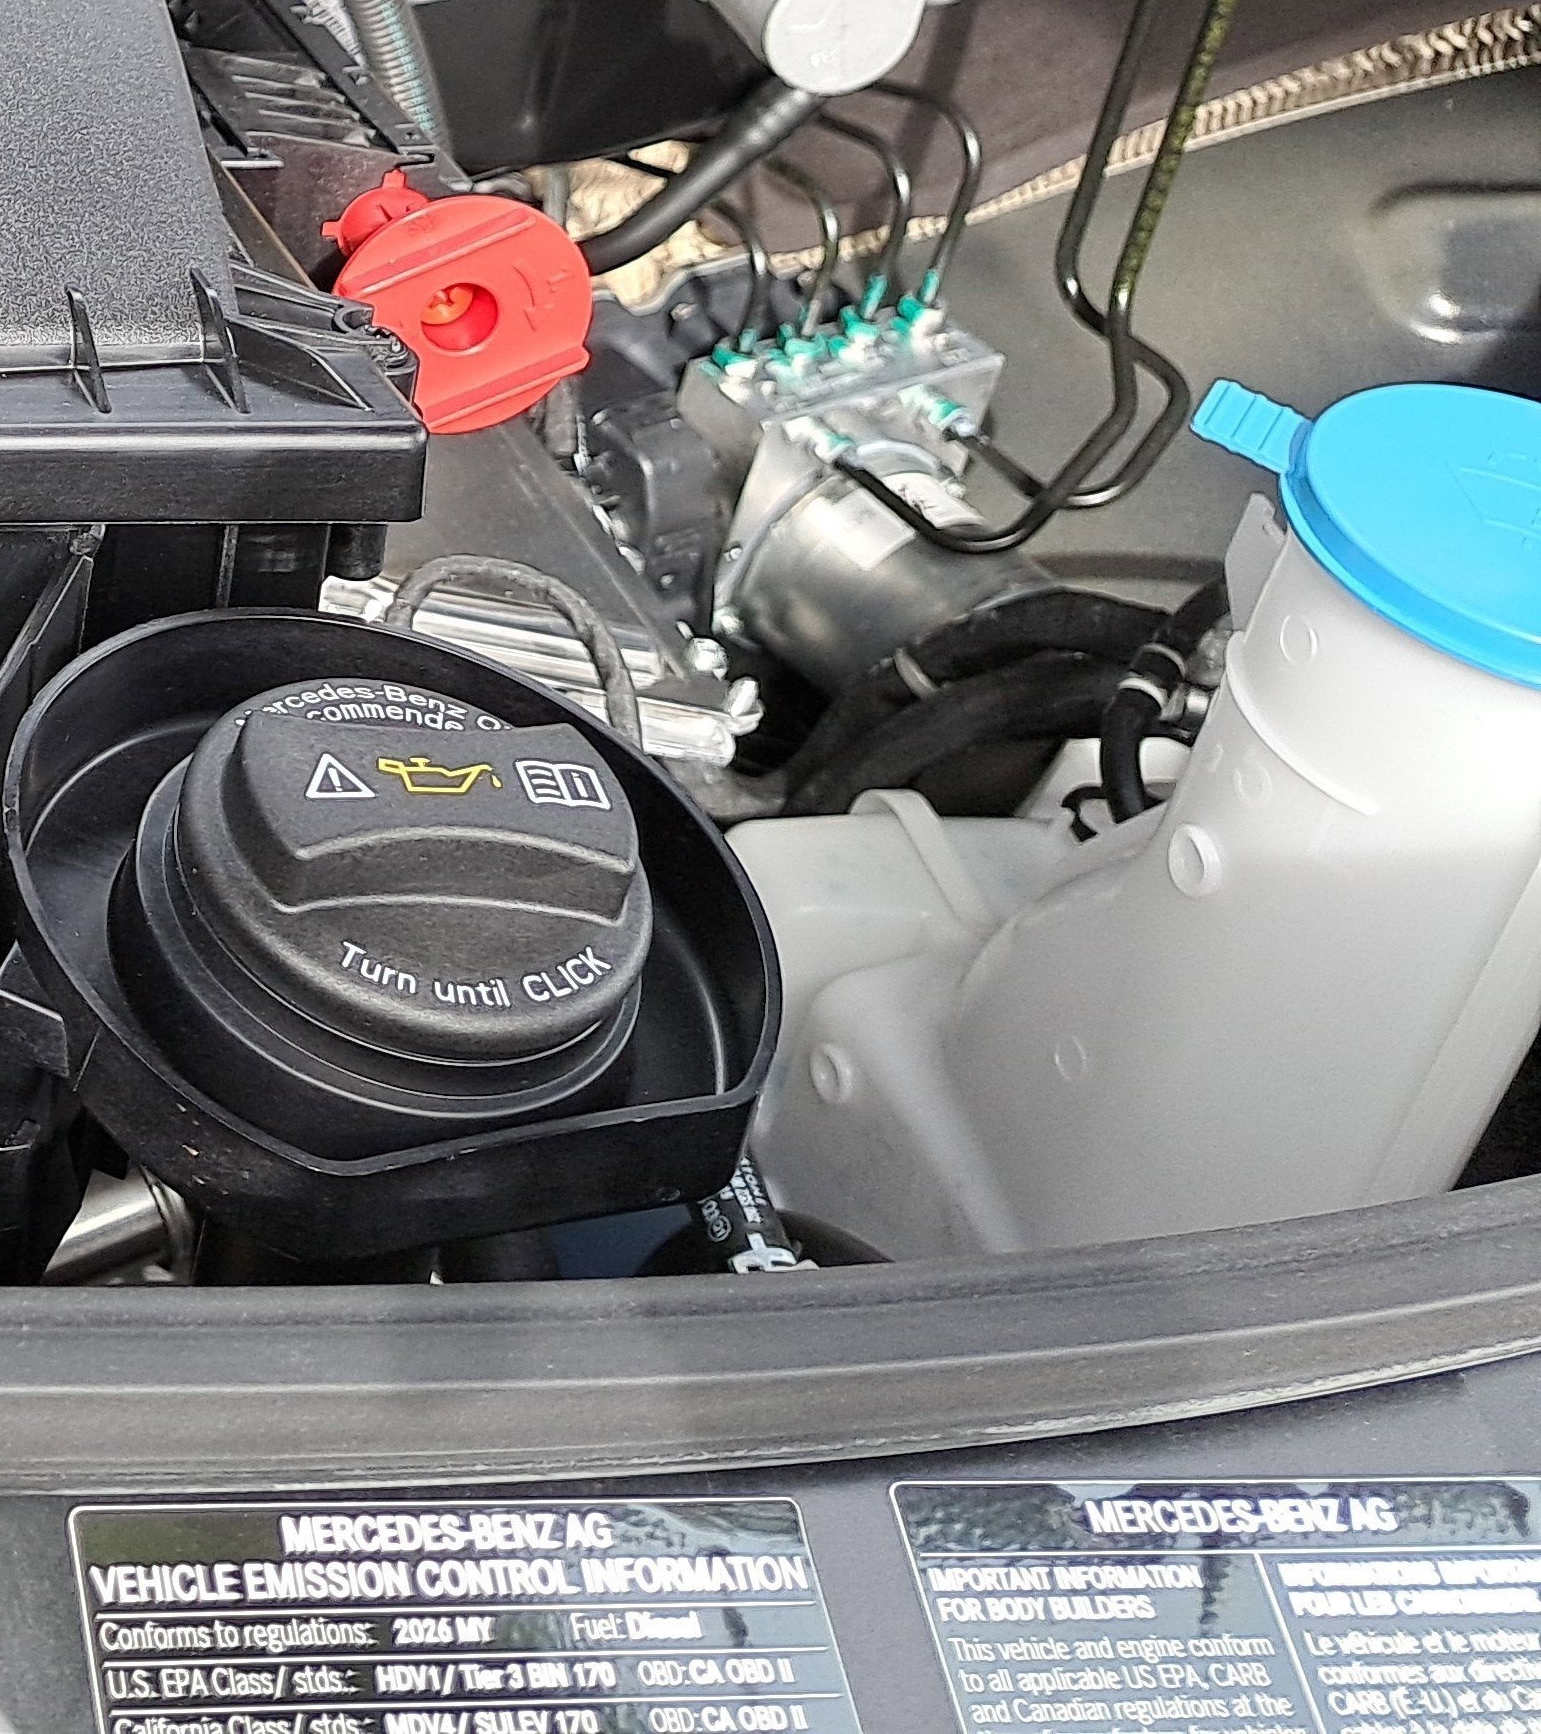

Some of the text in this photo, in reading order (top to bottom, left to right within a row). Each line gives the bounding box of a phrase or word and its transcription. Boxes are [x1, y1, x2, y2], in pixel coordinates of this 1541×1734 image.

[341, 940, 612, 1008] Turn until CLICK
[1086, 1497, 1399, 1535] MERCEDES-BENZ AG
[279, 1512, 616, 1555] MERCEDES-BENZ AG
[89, 1554, 810, 1605] VEHICLE EMISSION CONTROL INFORMATION
[929, 1564, 1205, 1593] IMPORTANT INFORMATION
[936, 1595, 1158, 1623] FOR BODY BUILDERS
[99, 1620, 213, 1652] Conforms
[214, 1619, 240, 1649] to
[243, 1617, 376, 1654] regulations:
[392, 1617, 454, 1647] 2026
[456, 1615, 496, 1643] MY
[570, 1612, 626, 1642] Fuel:
[948, 1633, 1275, 1664] This vehicle and engine conform
[1303, 1629, 1337, 1656] Le
[106, 1669, 161, 1699] U.S.
[161, 1667, 209, 1698] EPA
[211, 1665, 287, 1702] Class/
[459, 1662, 505, 1691] Tier
[506, 1663, 523, 1689] 3
[528, 1662, 571, 1689] BIN
[573, 1661, 618, 1688] 170
[687, 1659, 724, 1684] CA
[725, 1658, 778, 1684] OBD
[958, 1662, 1273, 1697] to all applicable US EPA, CARB
[554, 1710, 599, 1734] 170
[701, 1705, 739, 1732] CA
[738, 1705, 788, 1731] OBD
[970, 1693, 1296, 1725] and Canadian regulations at the
[1328, 1690, 1392, 1716] CARB
